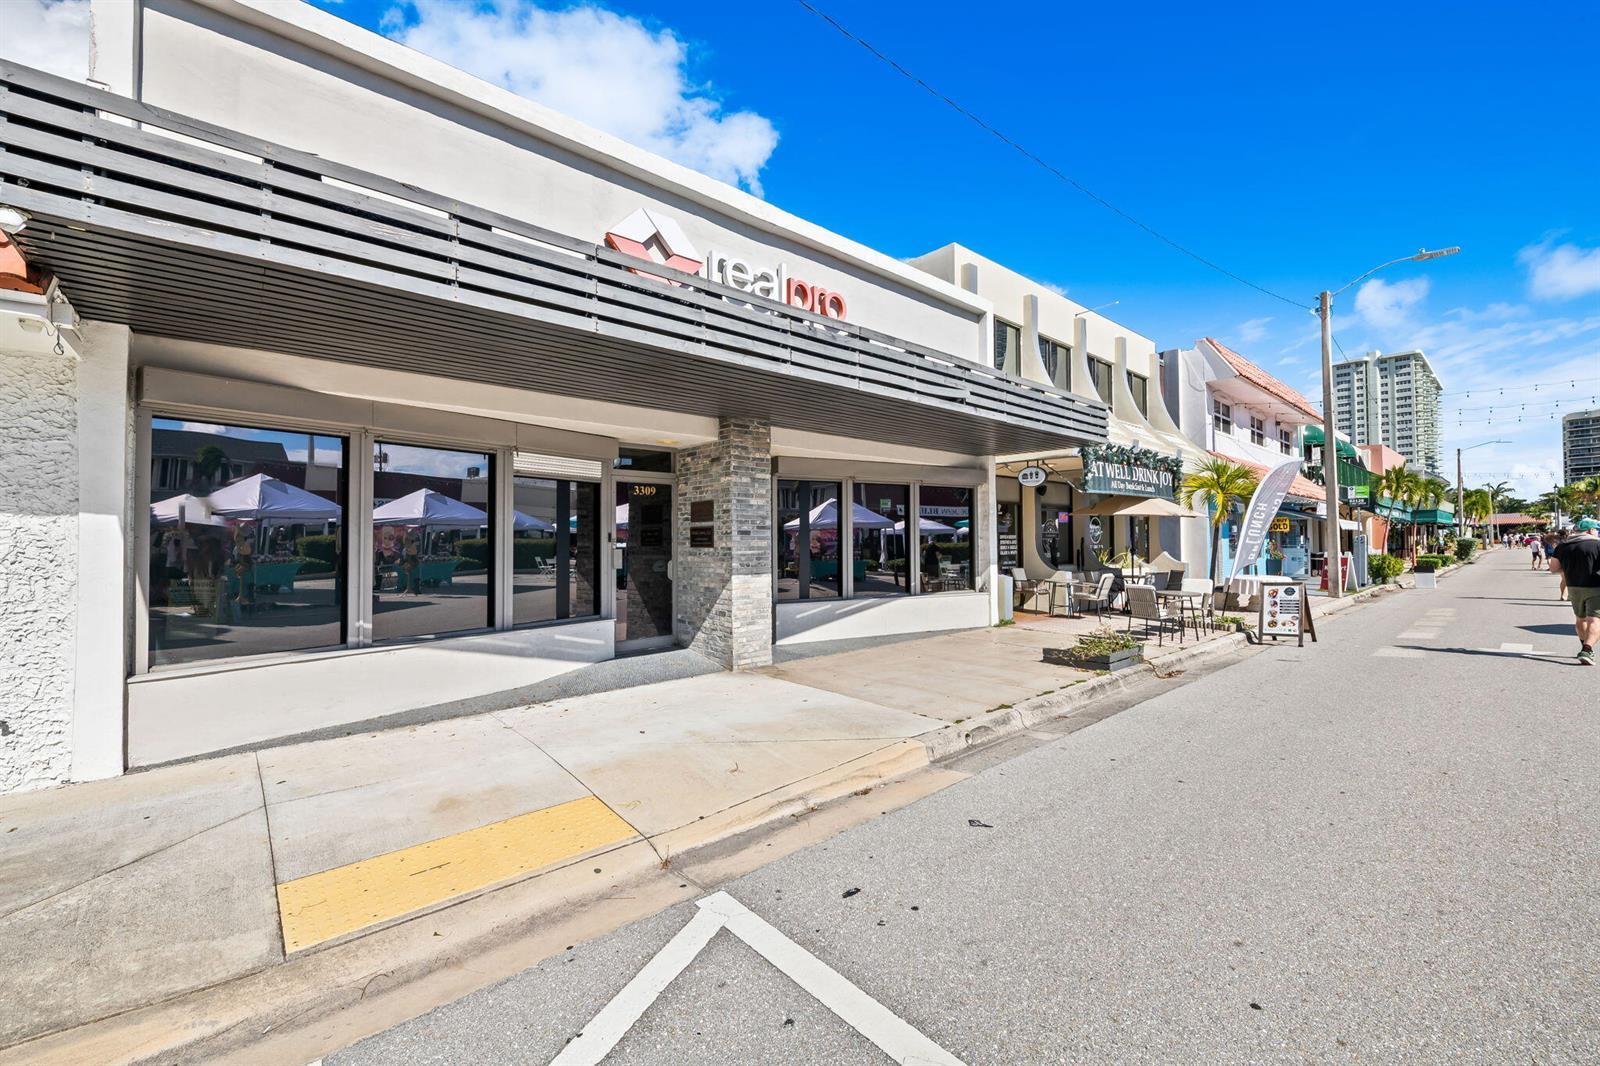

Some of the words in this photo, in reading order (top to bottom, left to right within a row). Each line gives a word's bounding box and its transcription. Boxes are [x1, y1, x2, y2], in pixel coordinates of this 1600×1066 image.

[1105, 462, 1130, 480] WELL
[1132, 466, 1159, 484] DRINK
[1160, 471, 1173, 488] JOY
[633, 485, 656, 496] 3309
